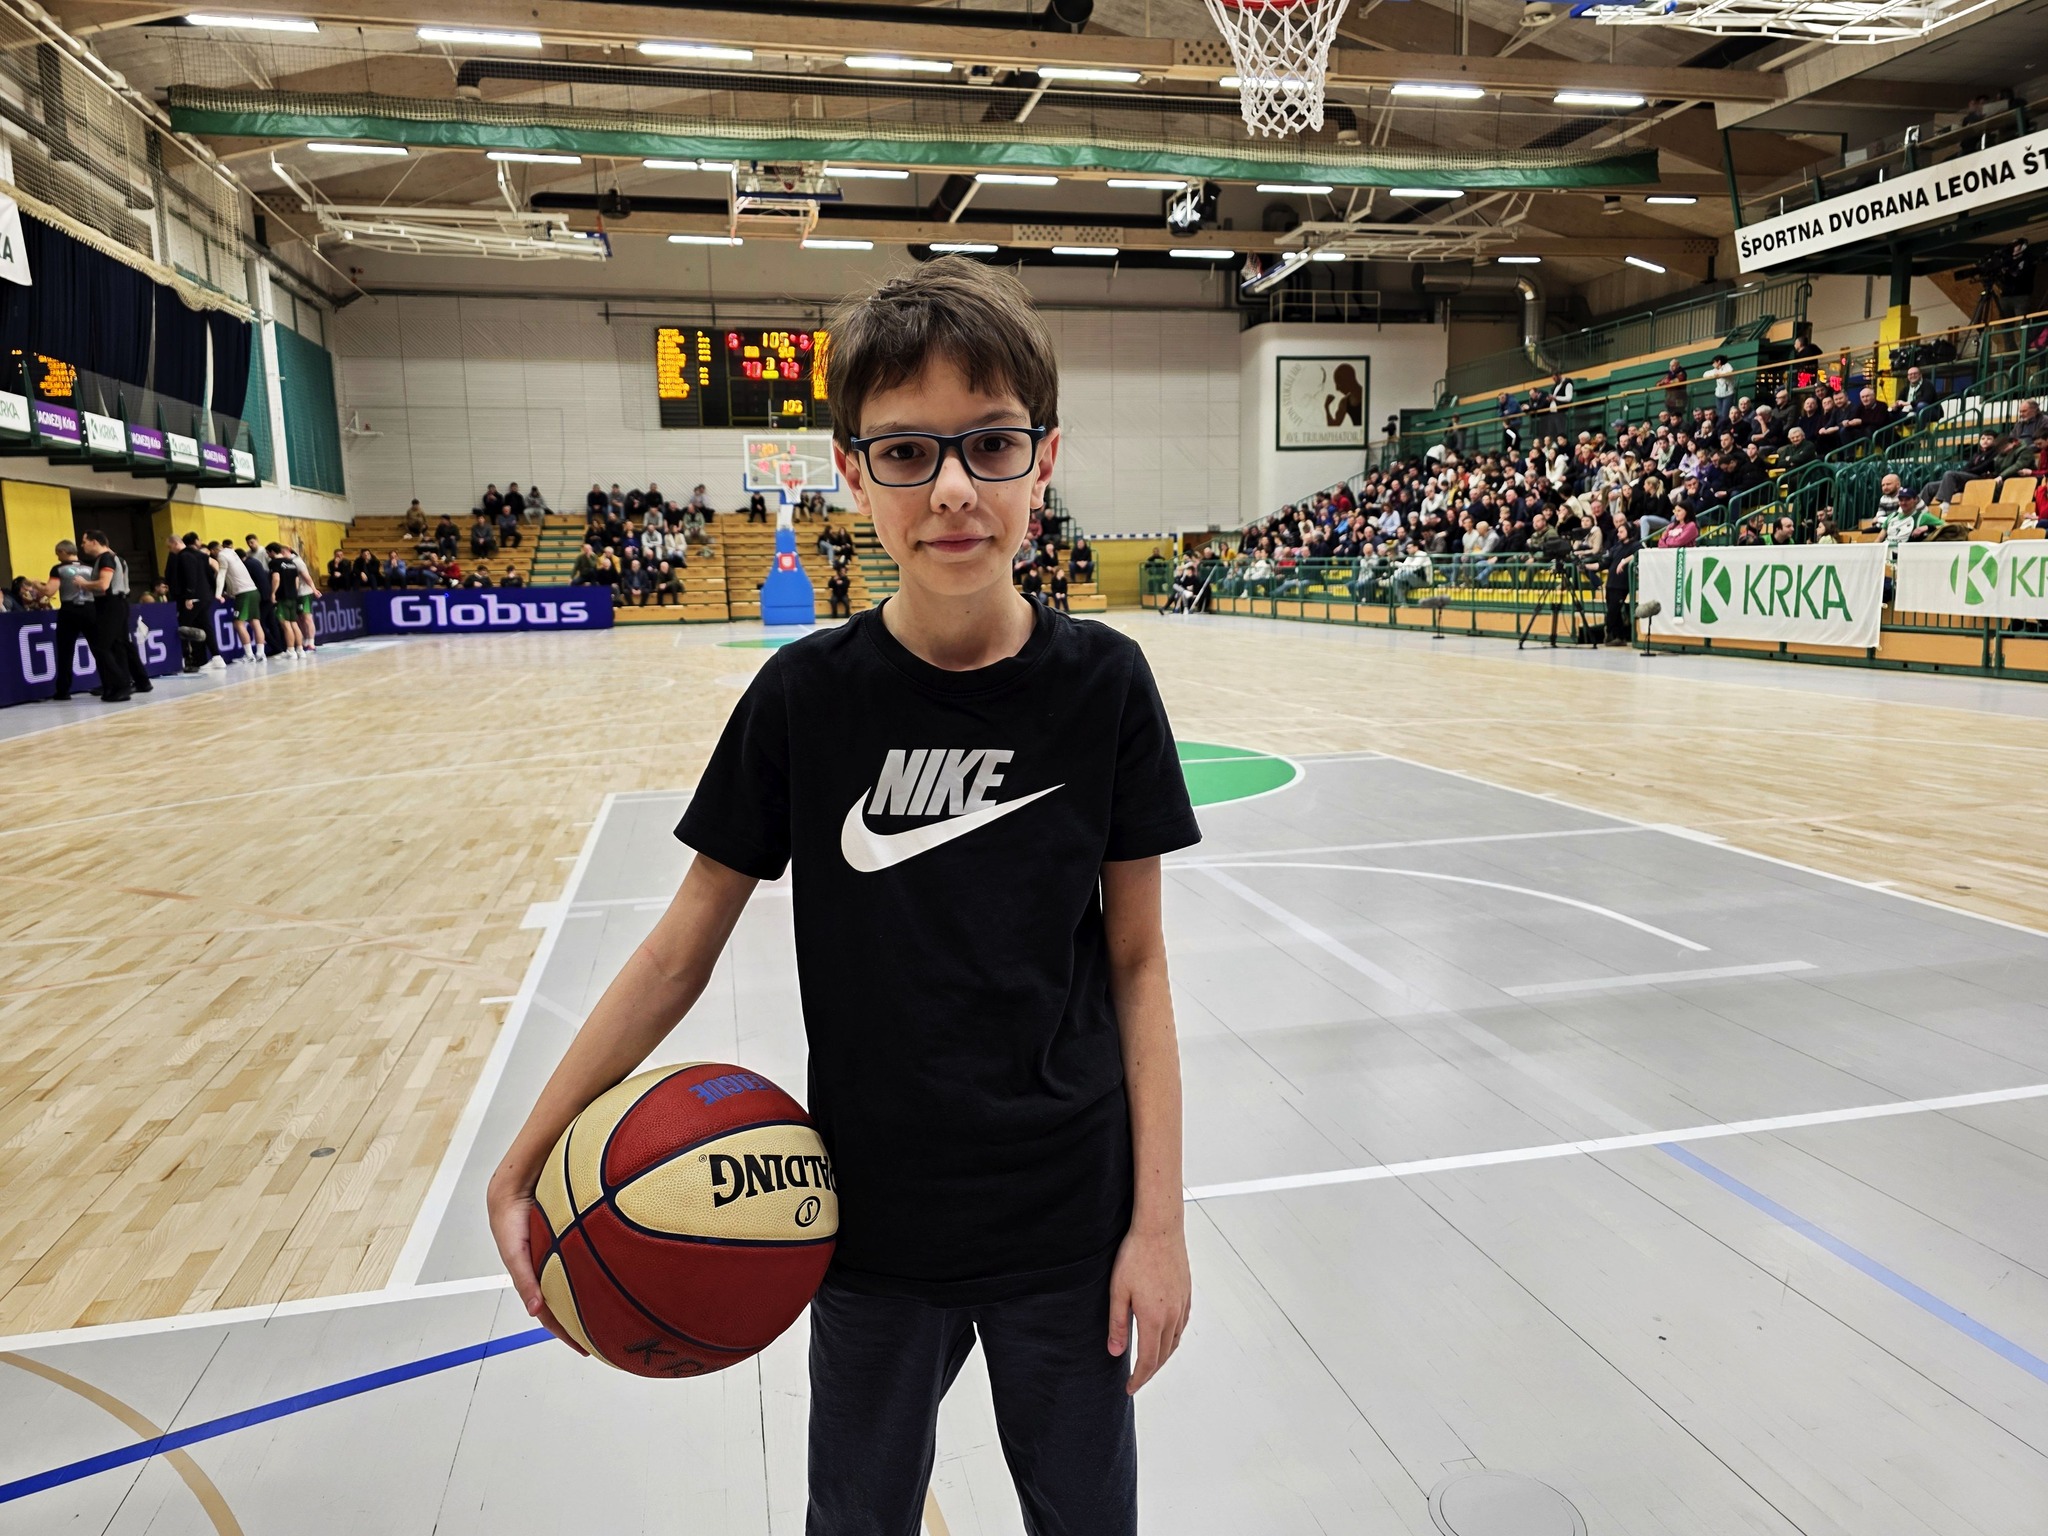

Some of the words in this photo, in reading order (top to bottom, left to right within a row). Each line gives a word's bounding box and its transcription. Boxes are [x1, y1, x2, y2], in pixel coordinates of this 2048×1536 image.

[1741, 218, 1824, 259] ŠPORTNA
[1829, 187, 1929, 233] DVORANA
[1935, 160, 2016, 203] LEONA
[390, 594, 588, 627] Globus
[1743, 564, 1853, 622] KRKA
[867, 749, 1015, 816] NIKE
